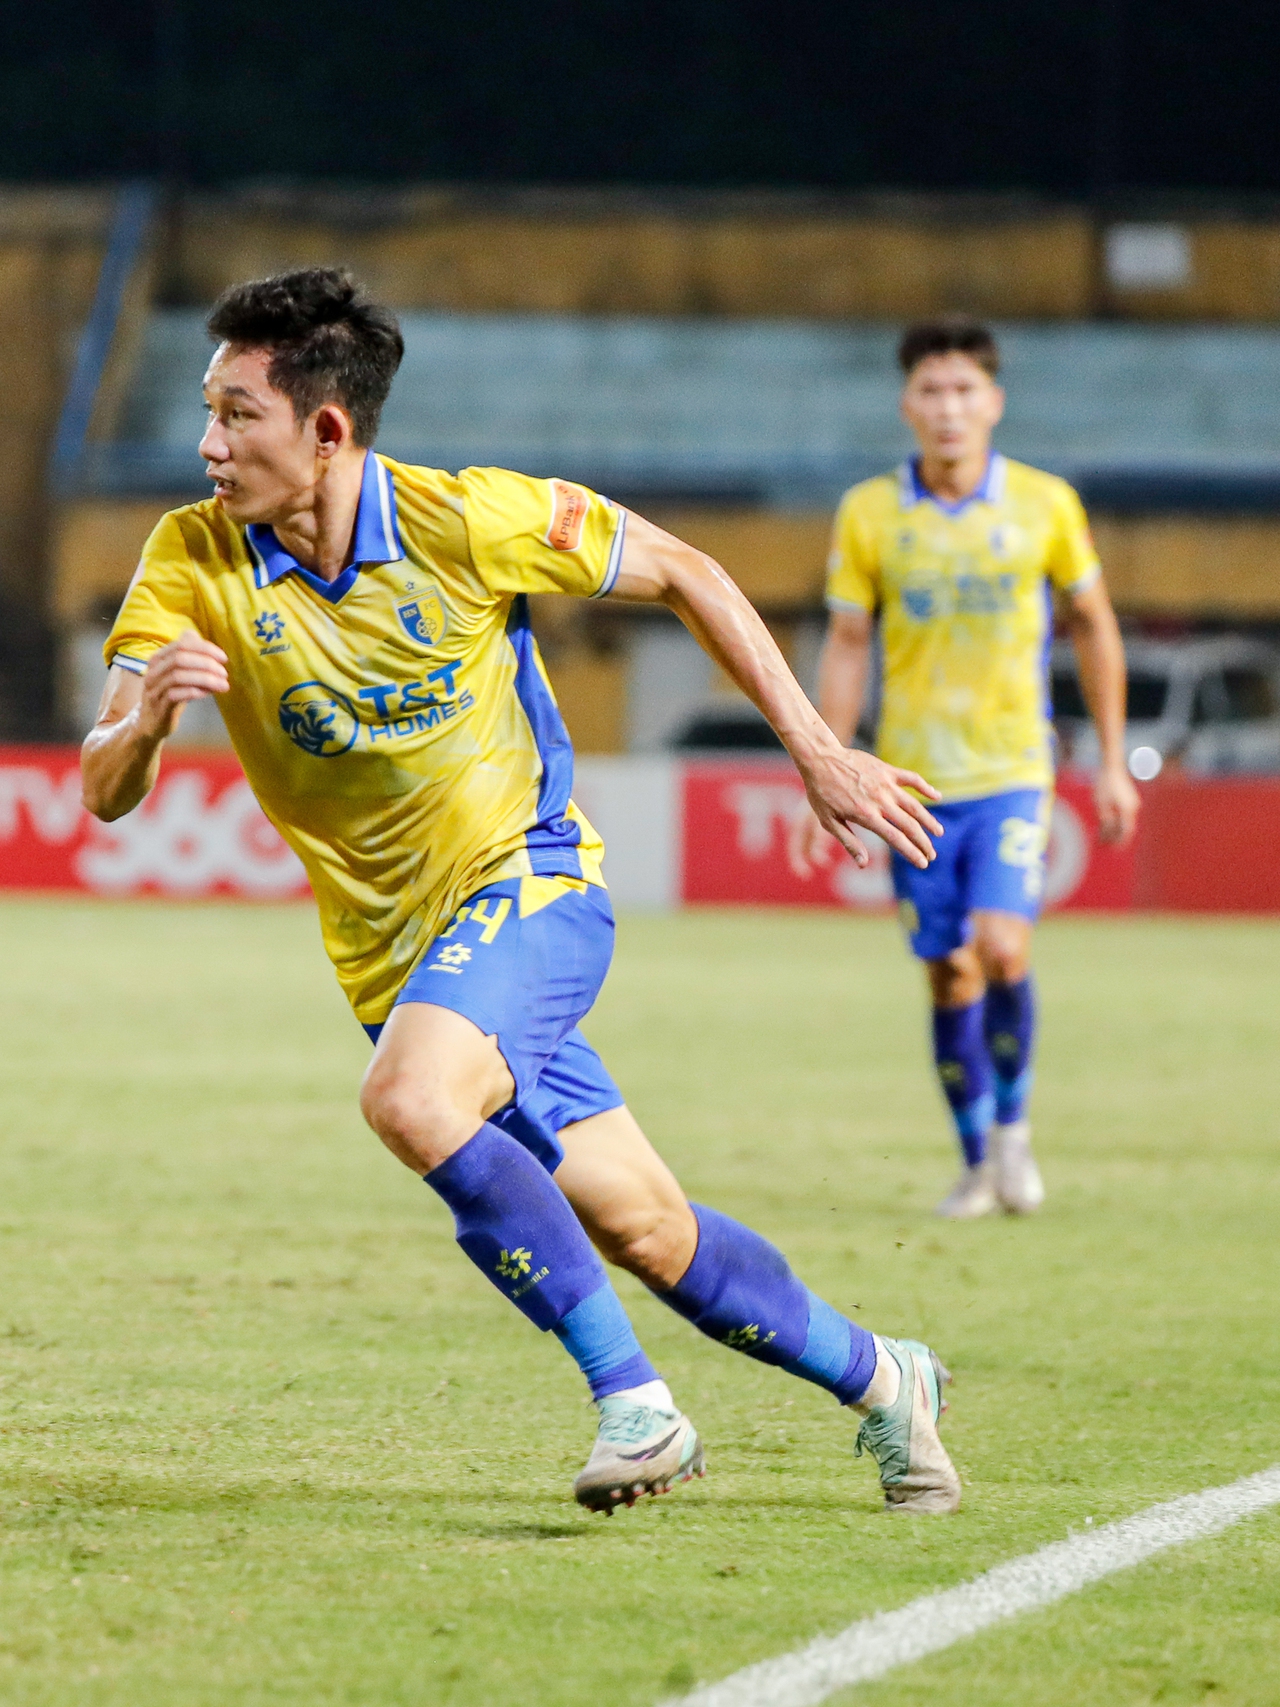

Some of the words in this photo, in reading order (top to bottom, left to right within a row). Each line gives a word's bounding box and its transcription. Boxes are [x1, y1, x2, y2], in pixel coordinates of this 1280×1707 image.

[556, 494, 576, 544] LPBank
[358, 659, 462, 725] T&T
[369, 688, 475, 743] HOMES
